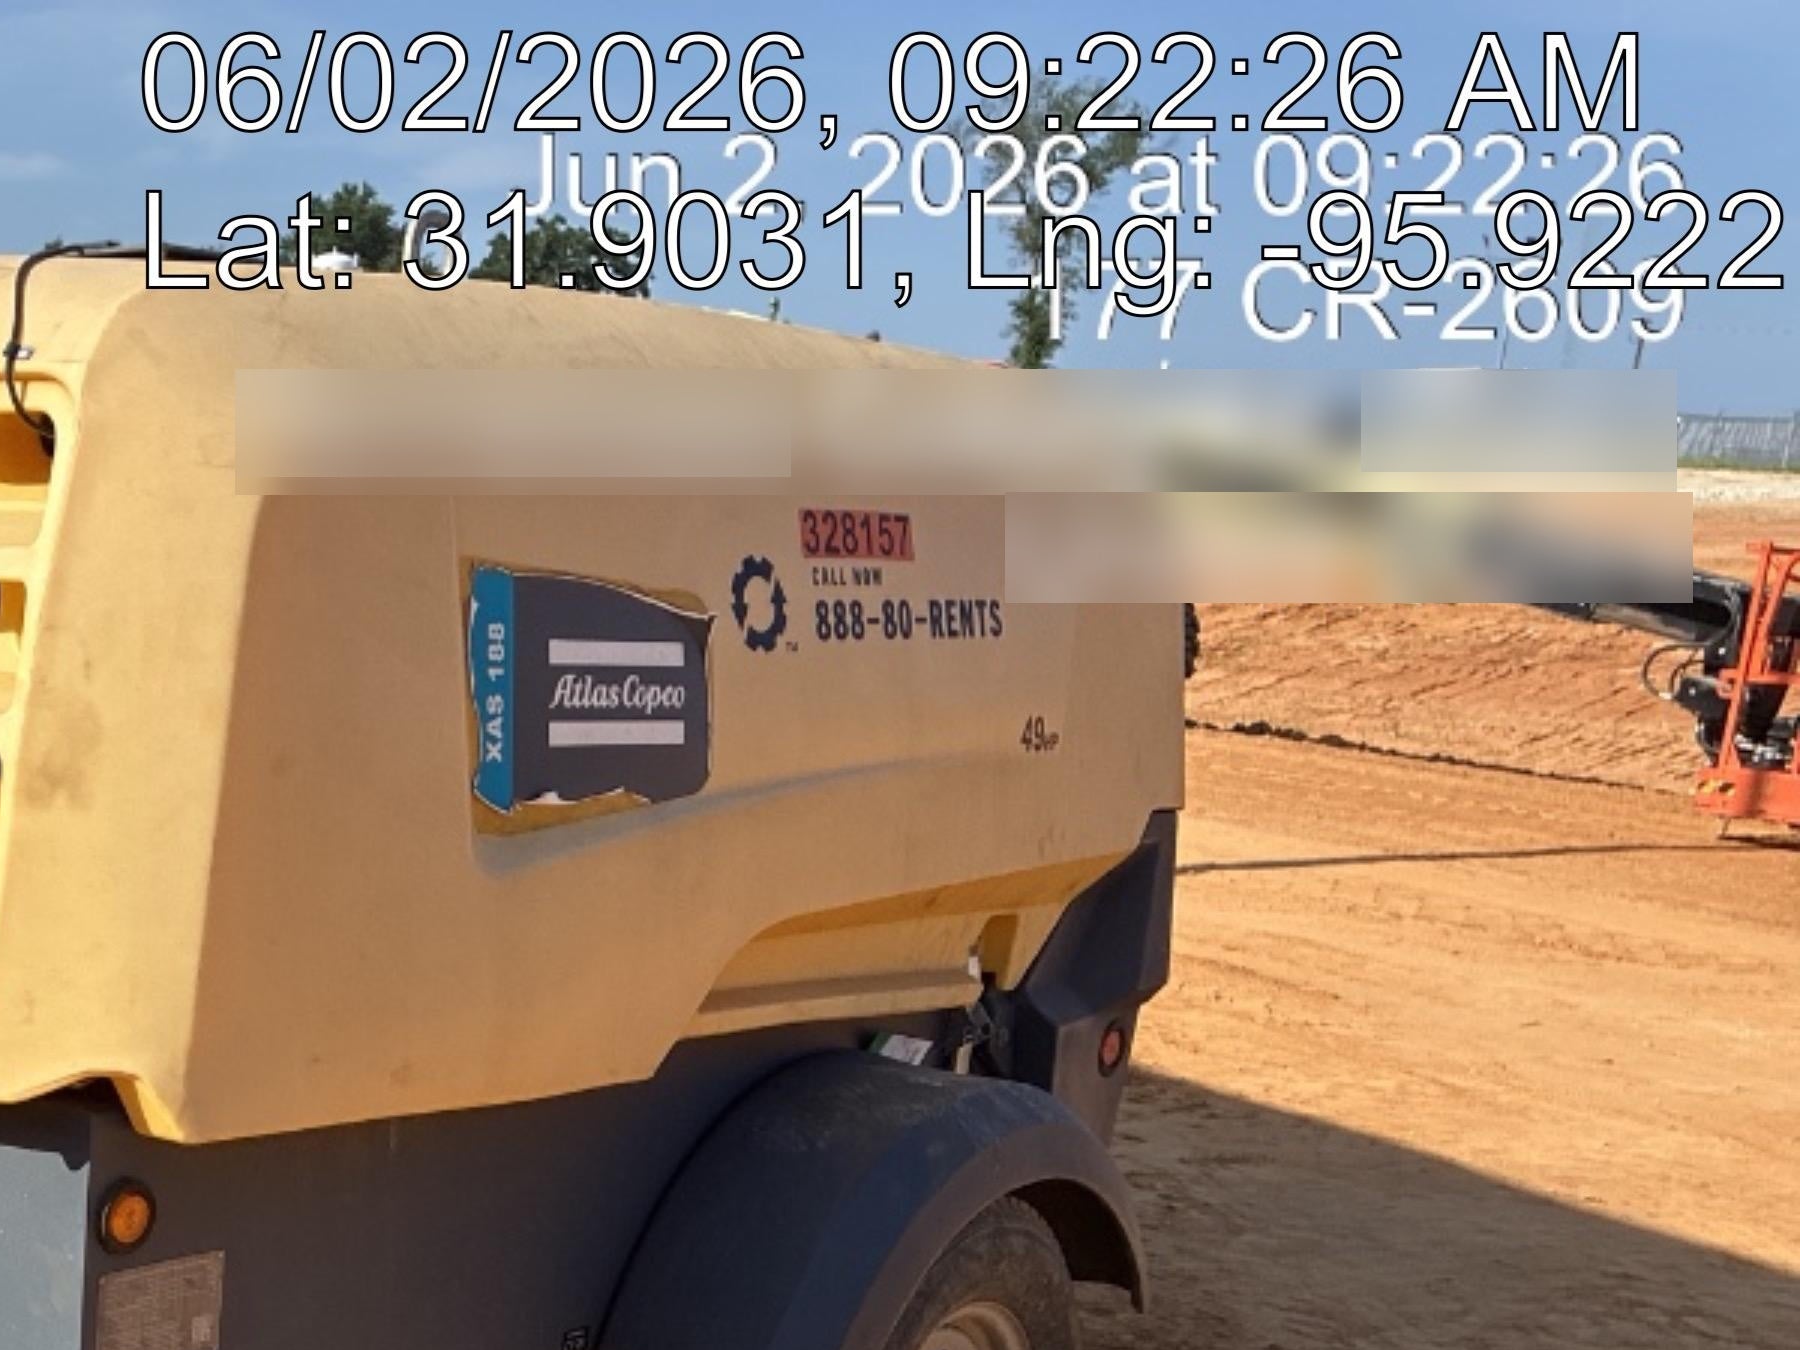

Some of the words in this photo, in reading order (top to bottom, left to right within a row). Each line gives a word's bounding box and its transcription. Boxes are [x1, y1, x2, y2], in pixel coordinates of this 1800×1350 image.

[802, 510, 910, 556] 328157
[812, 566, 847, 586] CALL
[815, 599, 1003, 641] 888-80-RENTS
[548, 673, 621, 709] Atlas
[485, 695, 505, 762] XAS
